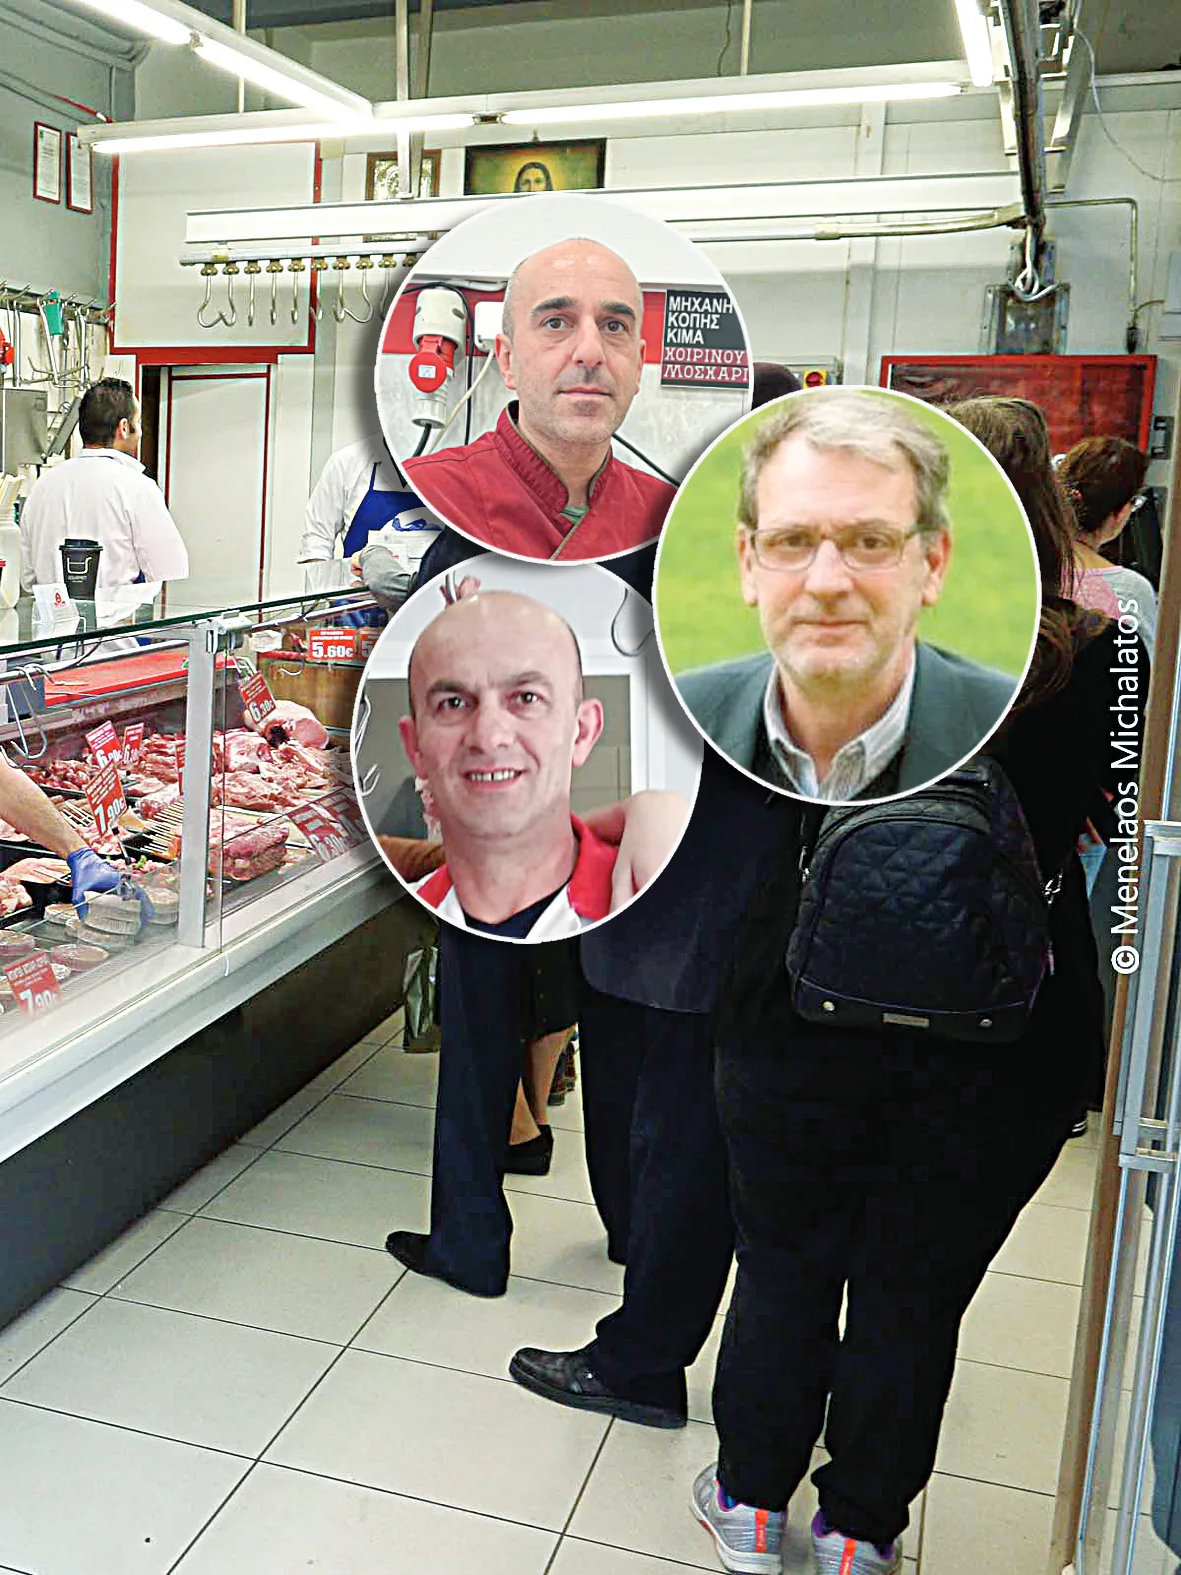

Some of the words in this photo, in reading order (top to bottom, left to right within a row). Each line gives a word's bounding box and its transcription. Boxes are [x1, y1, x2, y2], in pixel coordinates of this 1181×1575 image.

[669, 296, 733, 314] ΜΗΧΑΝΗ
[667, 312, 721, 330] ΚΟΠΗΣ
[666, 328, 704, 345] ΚΙΜΑ
[665, 346, 745, 364] ΧΟΙΡΙΝΟΥ
[311, 642, 354, 658] 5.60€
